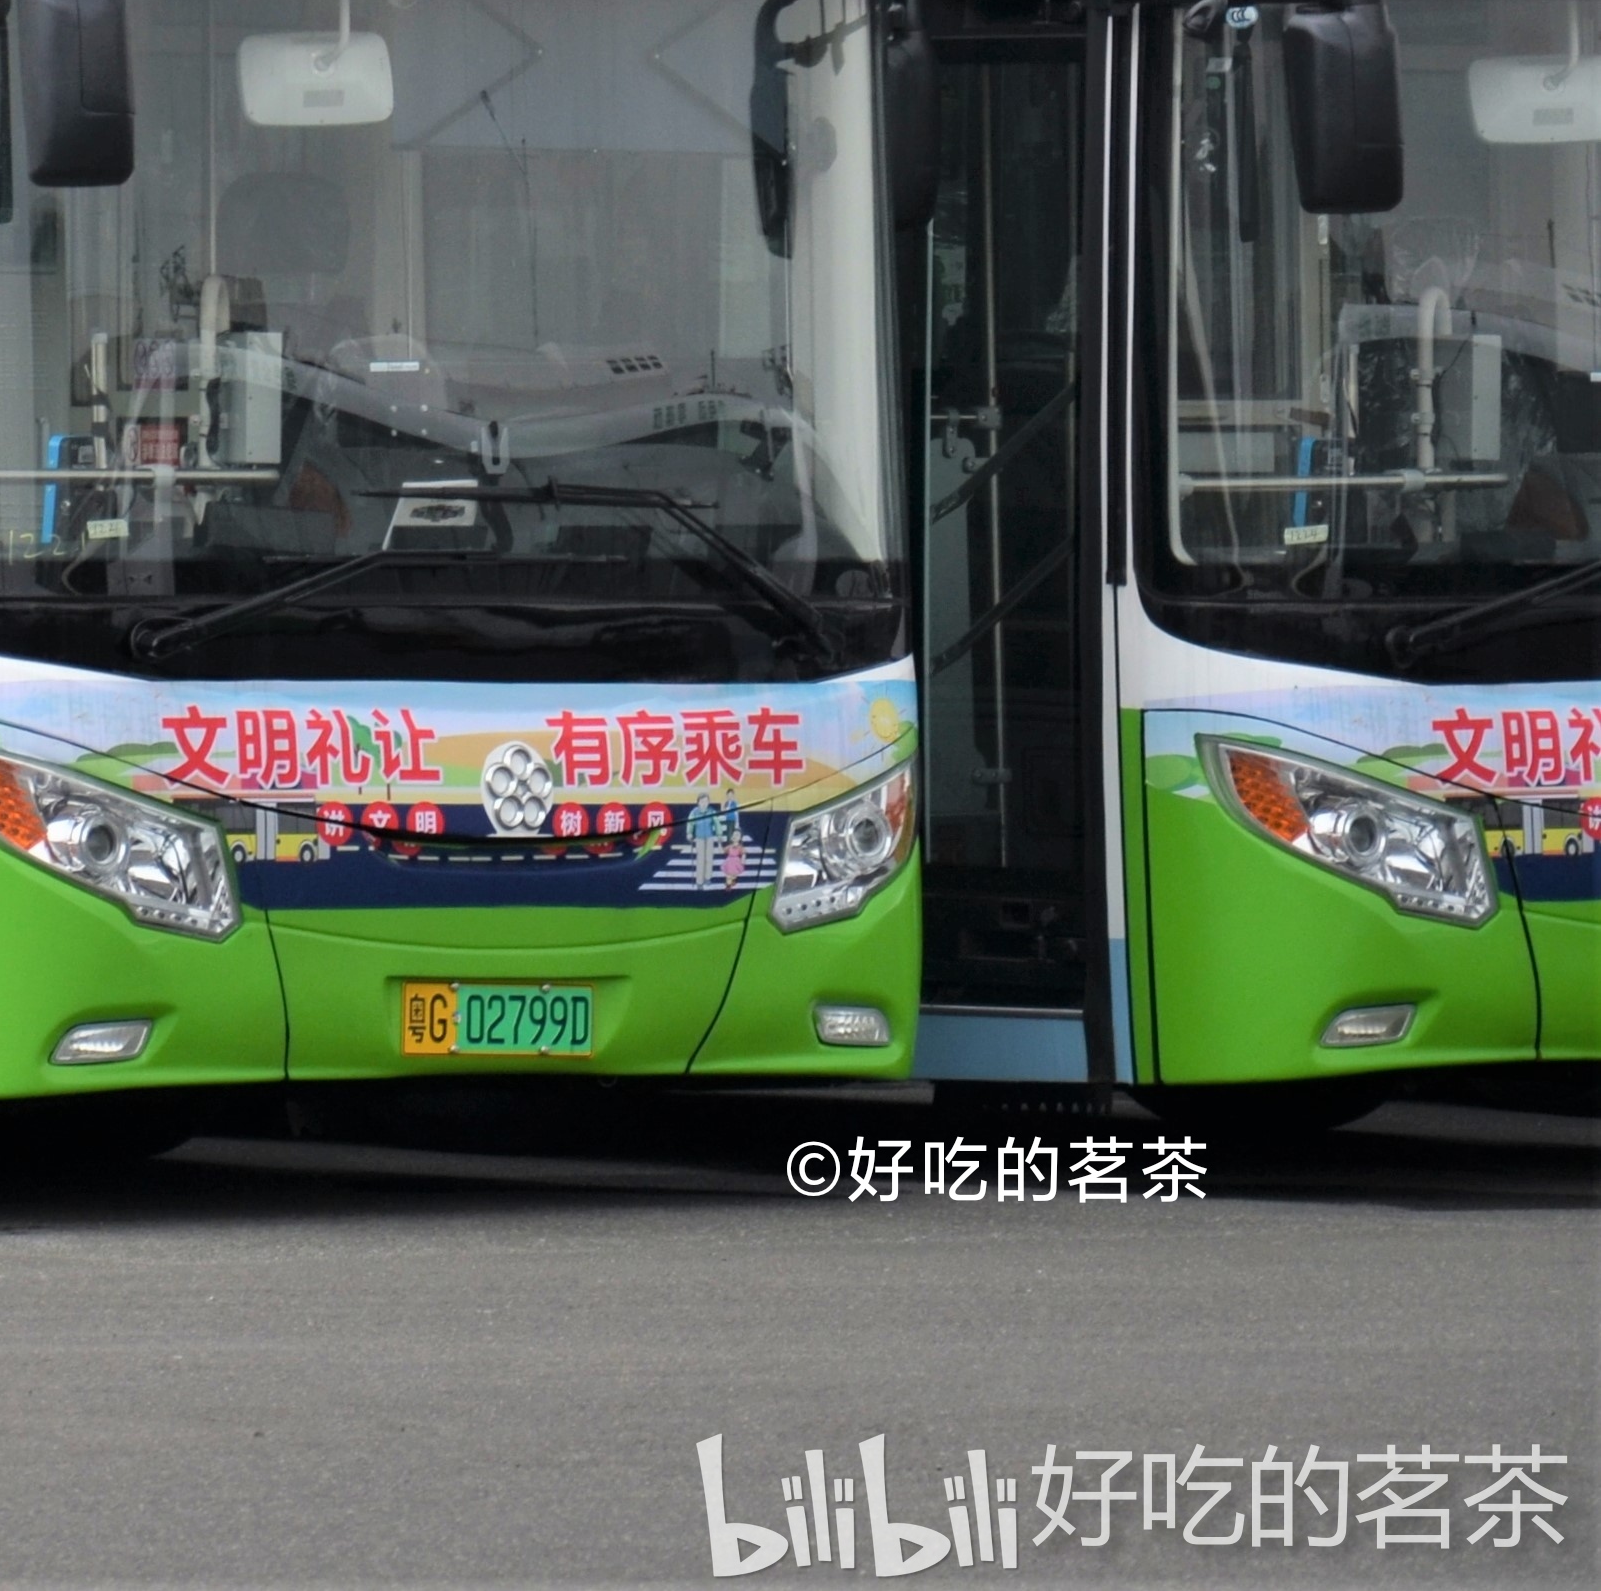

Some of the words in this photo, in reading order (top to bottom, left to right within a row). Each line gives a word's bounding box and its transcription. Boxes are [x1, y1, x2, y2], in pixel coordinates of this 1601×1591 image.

[162, 705, 441, 787] 文明礼让
[545, 707, 804, 786] 有序乘车
